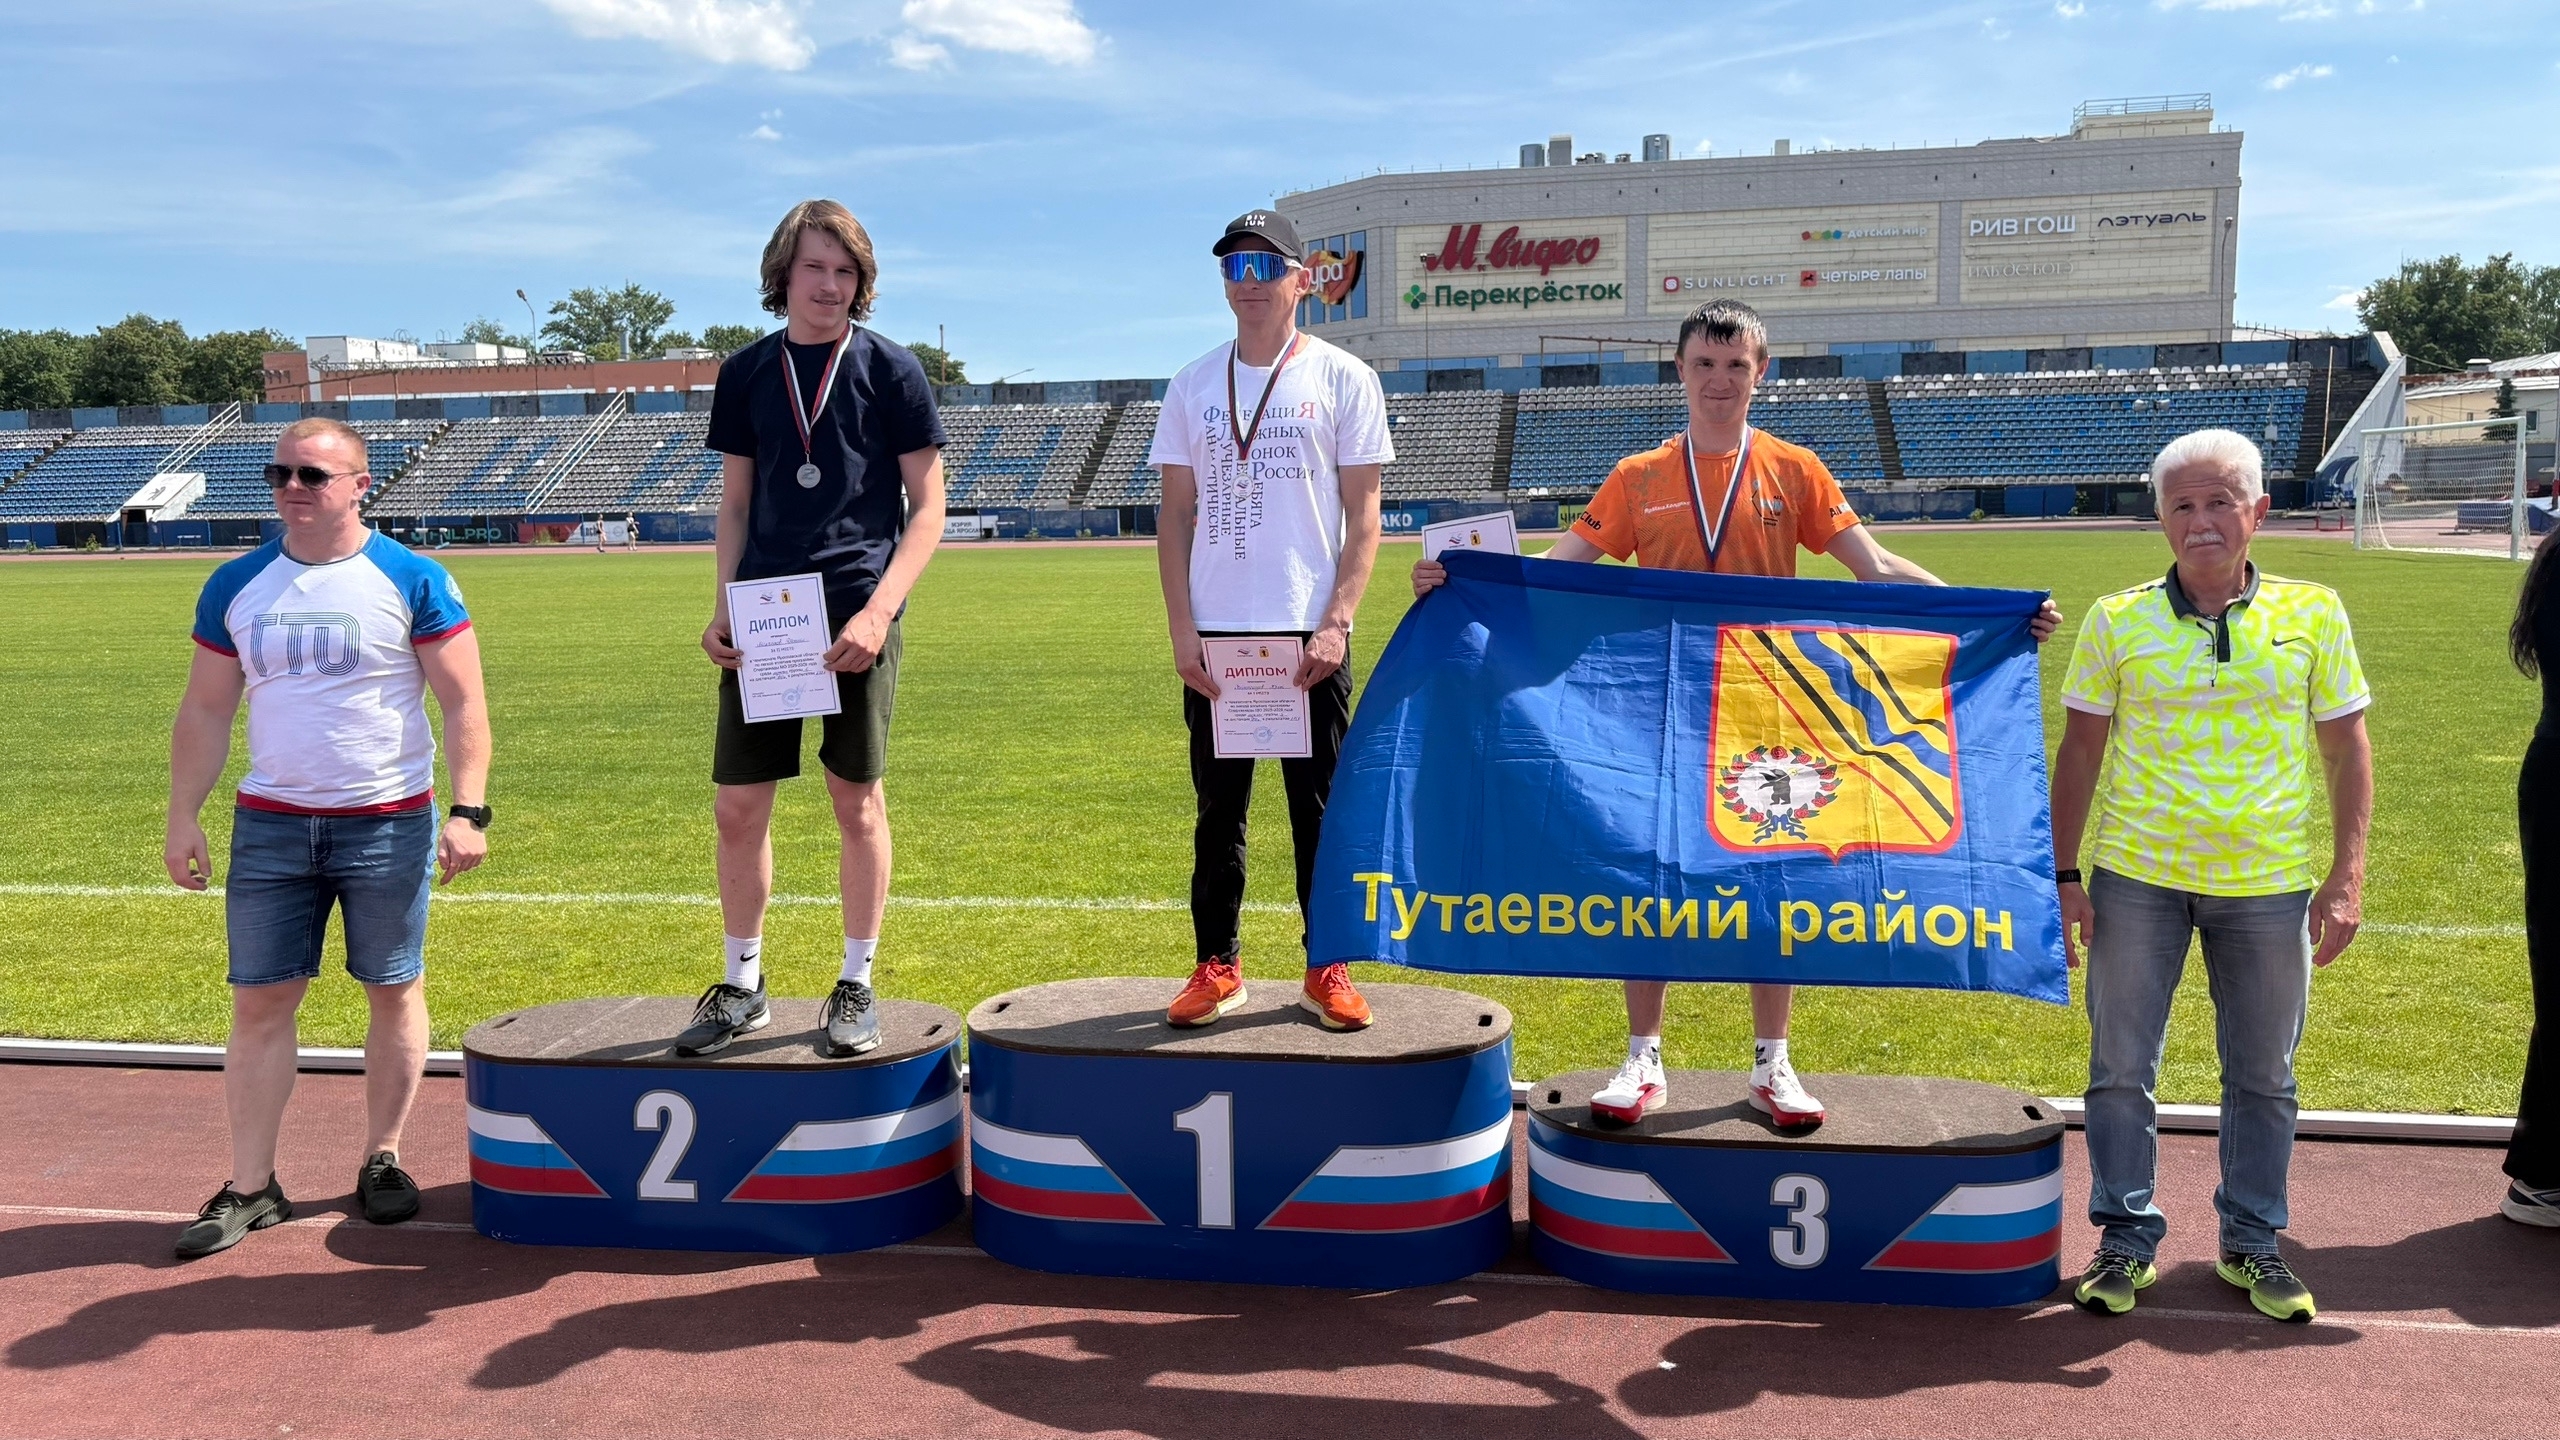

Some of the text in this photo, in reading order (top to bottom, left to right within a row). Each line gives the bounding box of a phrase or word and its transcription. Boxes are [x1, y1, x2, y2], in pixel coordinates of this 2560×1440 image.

[1902, 226, 1928, 238] мир
[1969, 215, 2077, 237] РИВ ГОШ
[1310, 262, 1344, 293] ура
[1684, 273, 1788, 291] SUNLIGHT
[1820, 267, 1928, 284] четыре лапы
[1434, 280, 1624, 312] Перекрёсток
[1202, 401, 1317, 424] ФЕЕАЦИЯ
[1217, 422, 1306, 441] ЛЖНЫХ
[1236, 446, 1297, 461] ОНОК
[1234, 462, 1249, 561] ЕАЛЬНЫЕ
[748, 614, 810, 635] ДИПЛОМ
[251, 611, 361, 678] ГТО
[1224, 667, 1288, 679] ДИПЛОМ
[1352, 871, 2013, 957] Тутаевский район
[633, 1088, 699, 1203] 2
[1173, 1090, 1236, 1230] 1
[1768, 1172, 1831, 1271] 3
